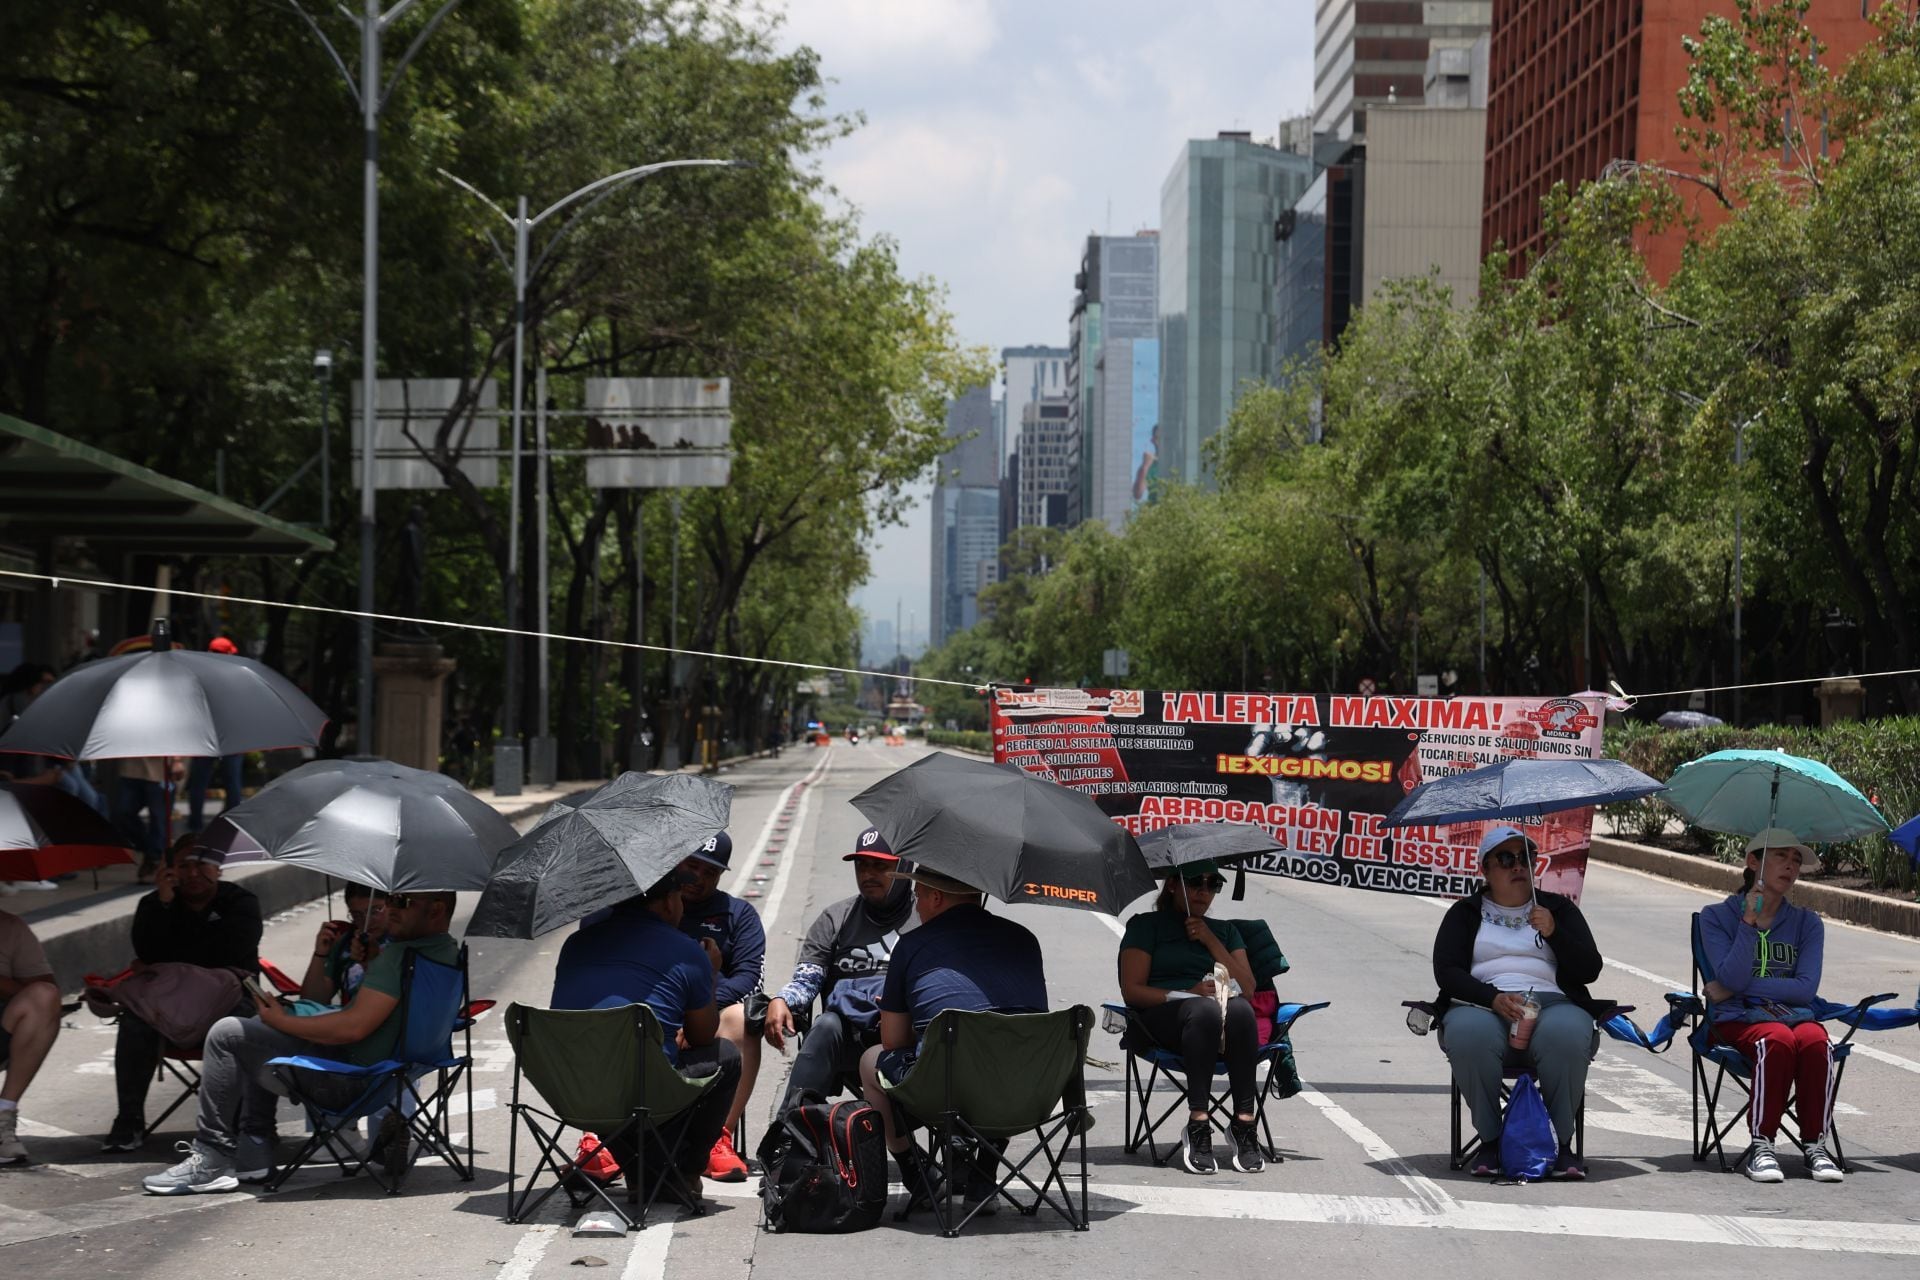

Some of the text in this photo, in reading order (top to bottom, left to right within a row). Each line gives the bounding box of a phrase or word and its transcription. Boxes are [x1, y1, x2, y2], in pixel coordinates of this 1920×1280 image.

[1113, 691, 1139, 706] 34
[1163, 693, 1503, 731] ¡ALERTA MÁXIMA!
[1005, 722, 1185, 736] JUBILACIÓN POR AÑOS DE SERVICIO
[1006, 738, 1193, 752] REGRESO AL SISTEMA DE SEGURIDAD
[1420, 733, 1592, 759] SERVICIOS DE SALUD DIGNOS SIN
[1045, 753, 1099, 766] SOLIDARIO
[1420, 748, 1454, 761] TOCAR
[1457, 750, 1469, 762] EL
[1059, 769, 1071, 781] NI
[1072, 768, 1113, 780] AFORES
[1217, 754, 1392, 783] ¡EXIGIMOS!
[1112, 783, 1127, 793] EN
[1128, 782, 1179, 793] SALARIOS
[1180, 780, 1227, 795] MÍNIMOS
[1140, 796, 1341, 835] ABROGACIÓN
[1296, 829, 1341, 857] LEY
[1342, 832, 1388, 863] DEL
[1392, 838, 1480, 872] ISSSTE
[1355, 863, 1484, 896] VENCEREM
[1041, 884, 1097, 903] TRUPER
